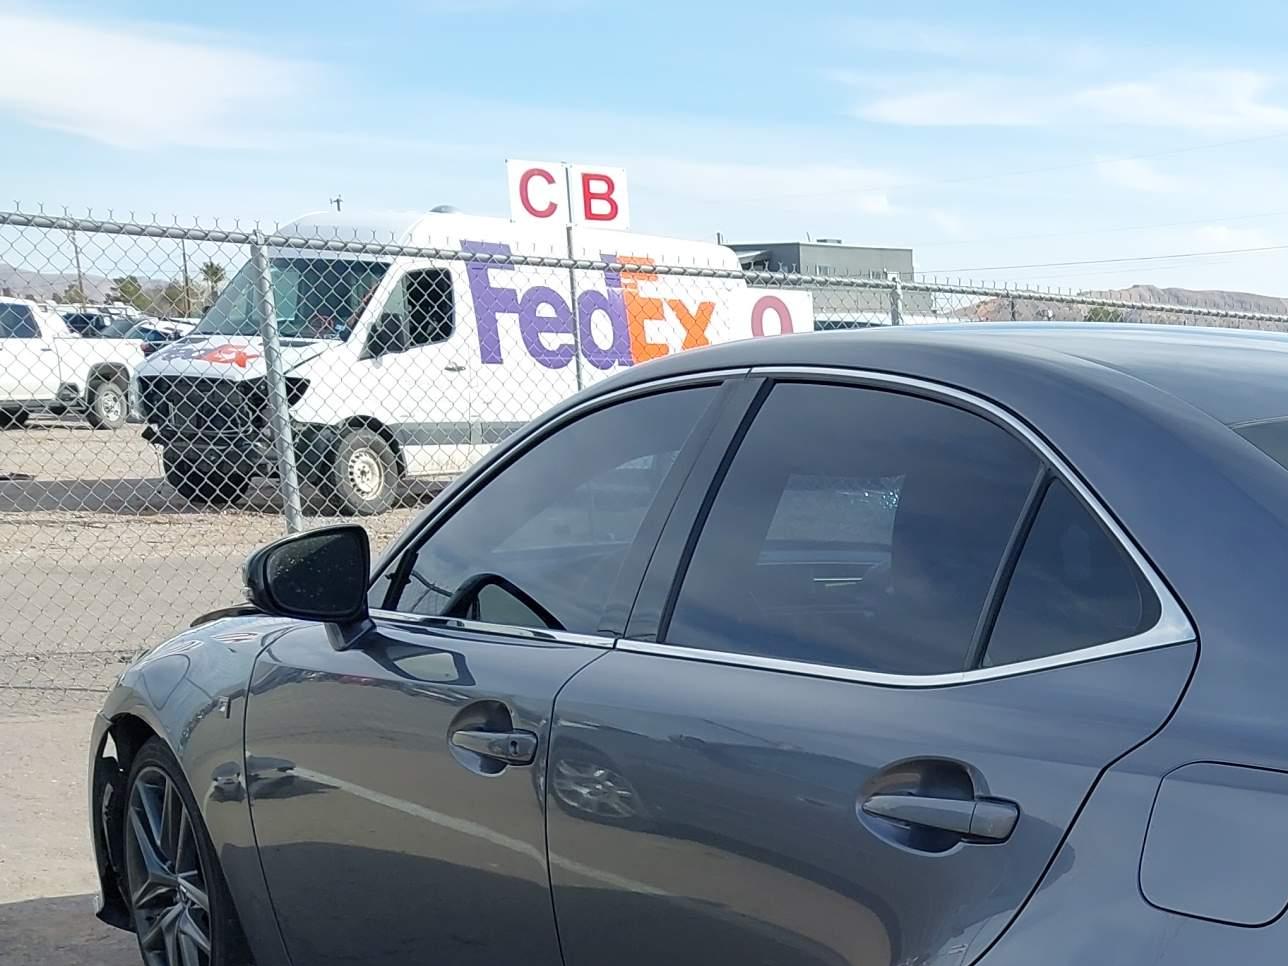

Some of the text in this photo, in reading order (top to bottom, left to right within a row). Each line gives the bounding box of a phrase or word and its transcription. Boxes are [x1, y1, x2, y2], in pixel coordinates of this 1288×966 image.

[519, 168, 558, 218] C
[581, 173, 619, 221] B
[459, 239, 717, 370] FedEx
